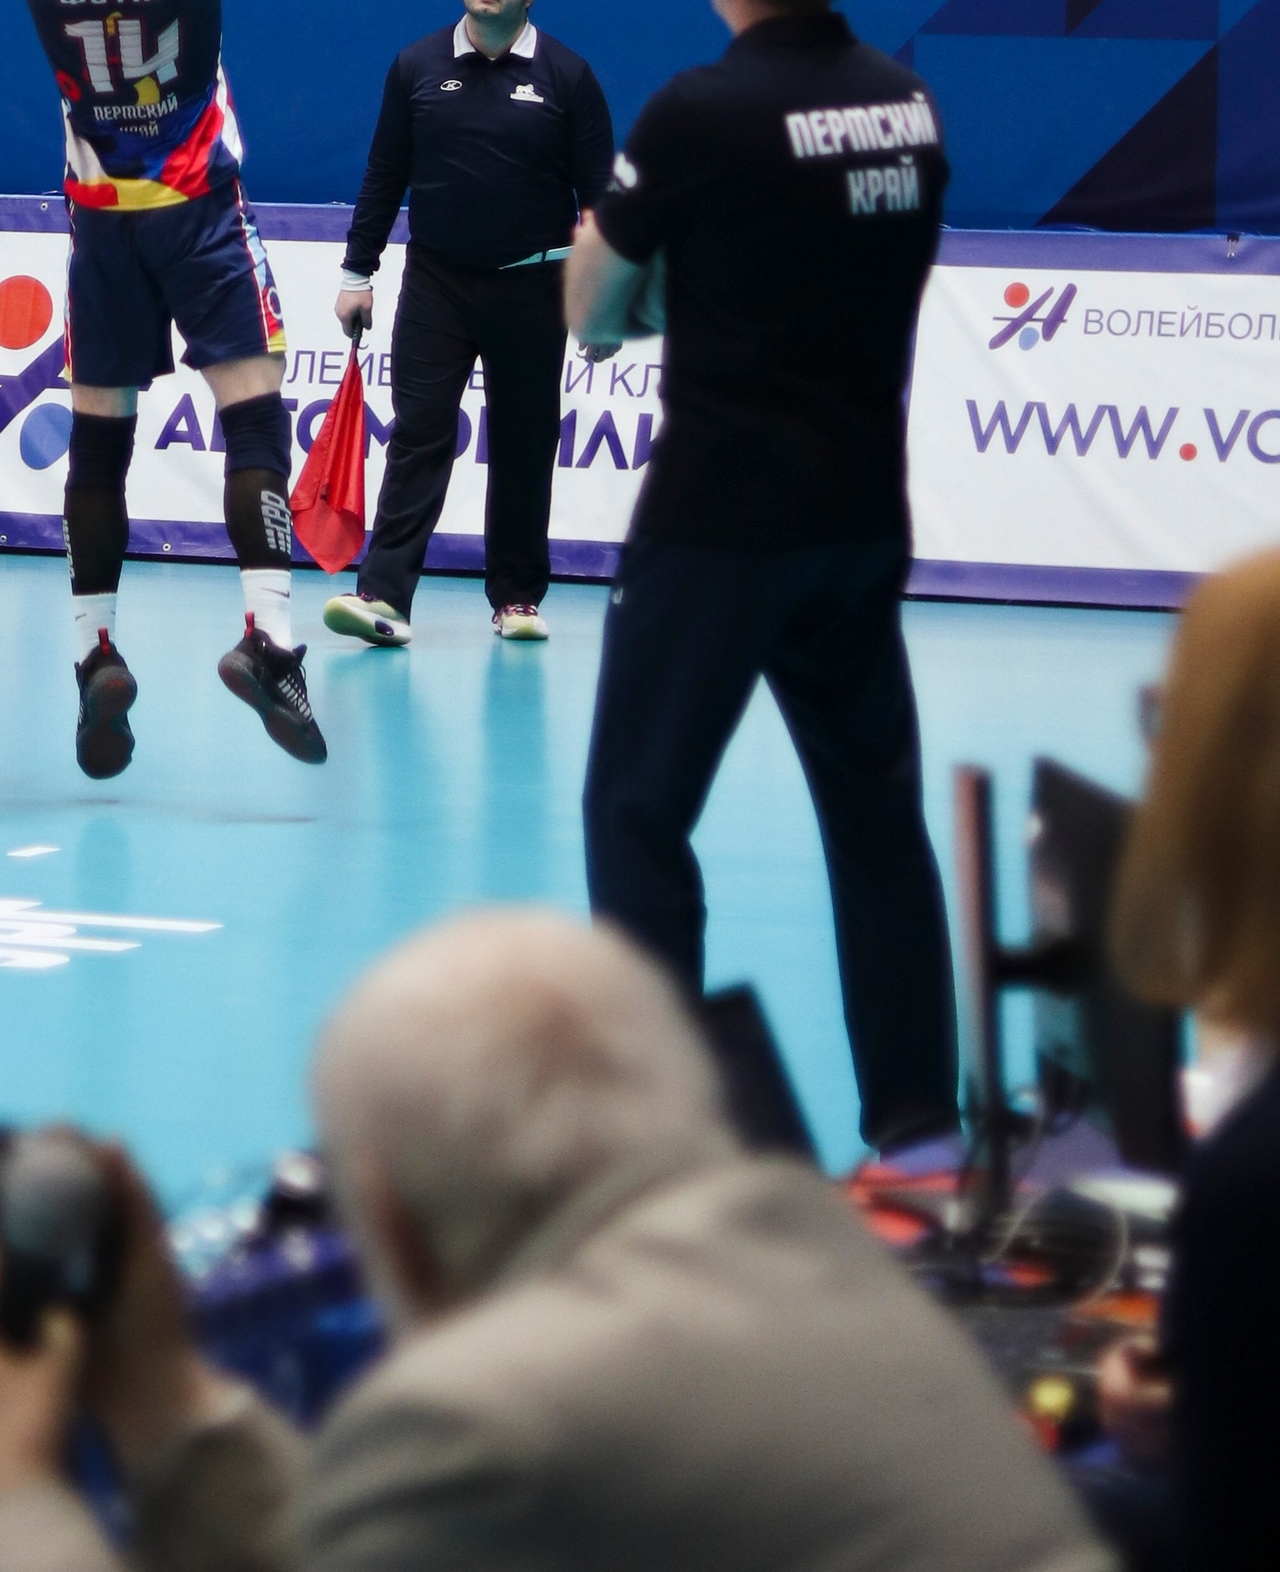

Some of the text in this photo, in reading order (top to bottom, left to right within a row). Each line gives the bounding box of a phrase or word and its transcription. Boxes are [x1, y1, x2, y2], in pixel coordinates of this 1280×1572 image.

[64, 17, 180, 94] 14
[785, 91, 939, 159] ПЕРМСКИЙ
[847, 156, 921, 216] КРАЙ
[1082, 304, 1280, 341] ВОЛЕЙБОЛ
